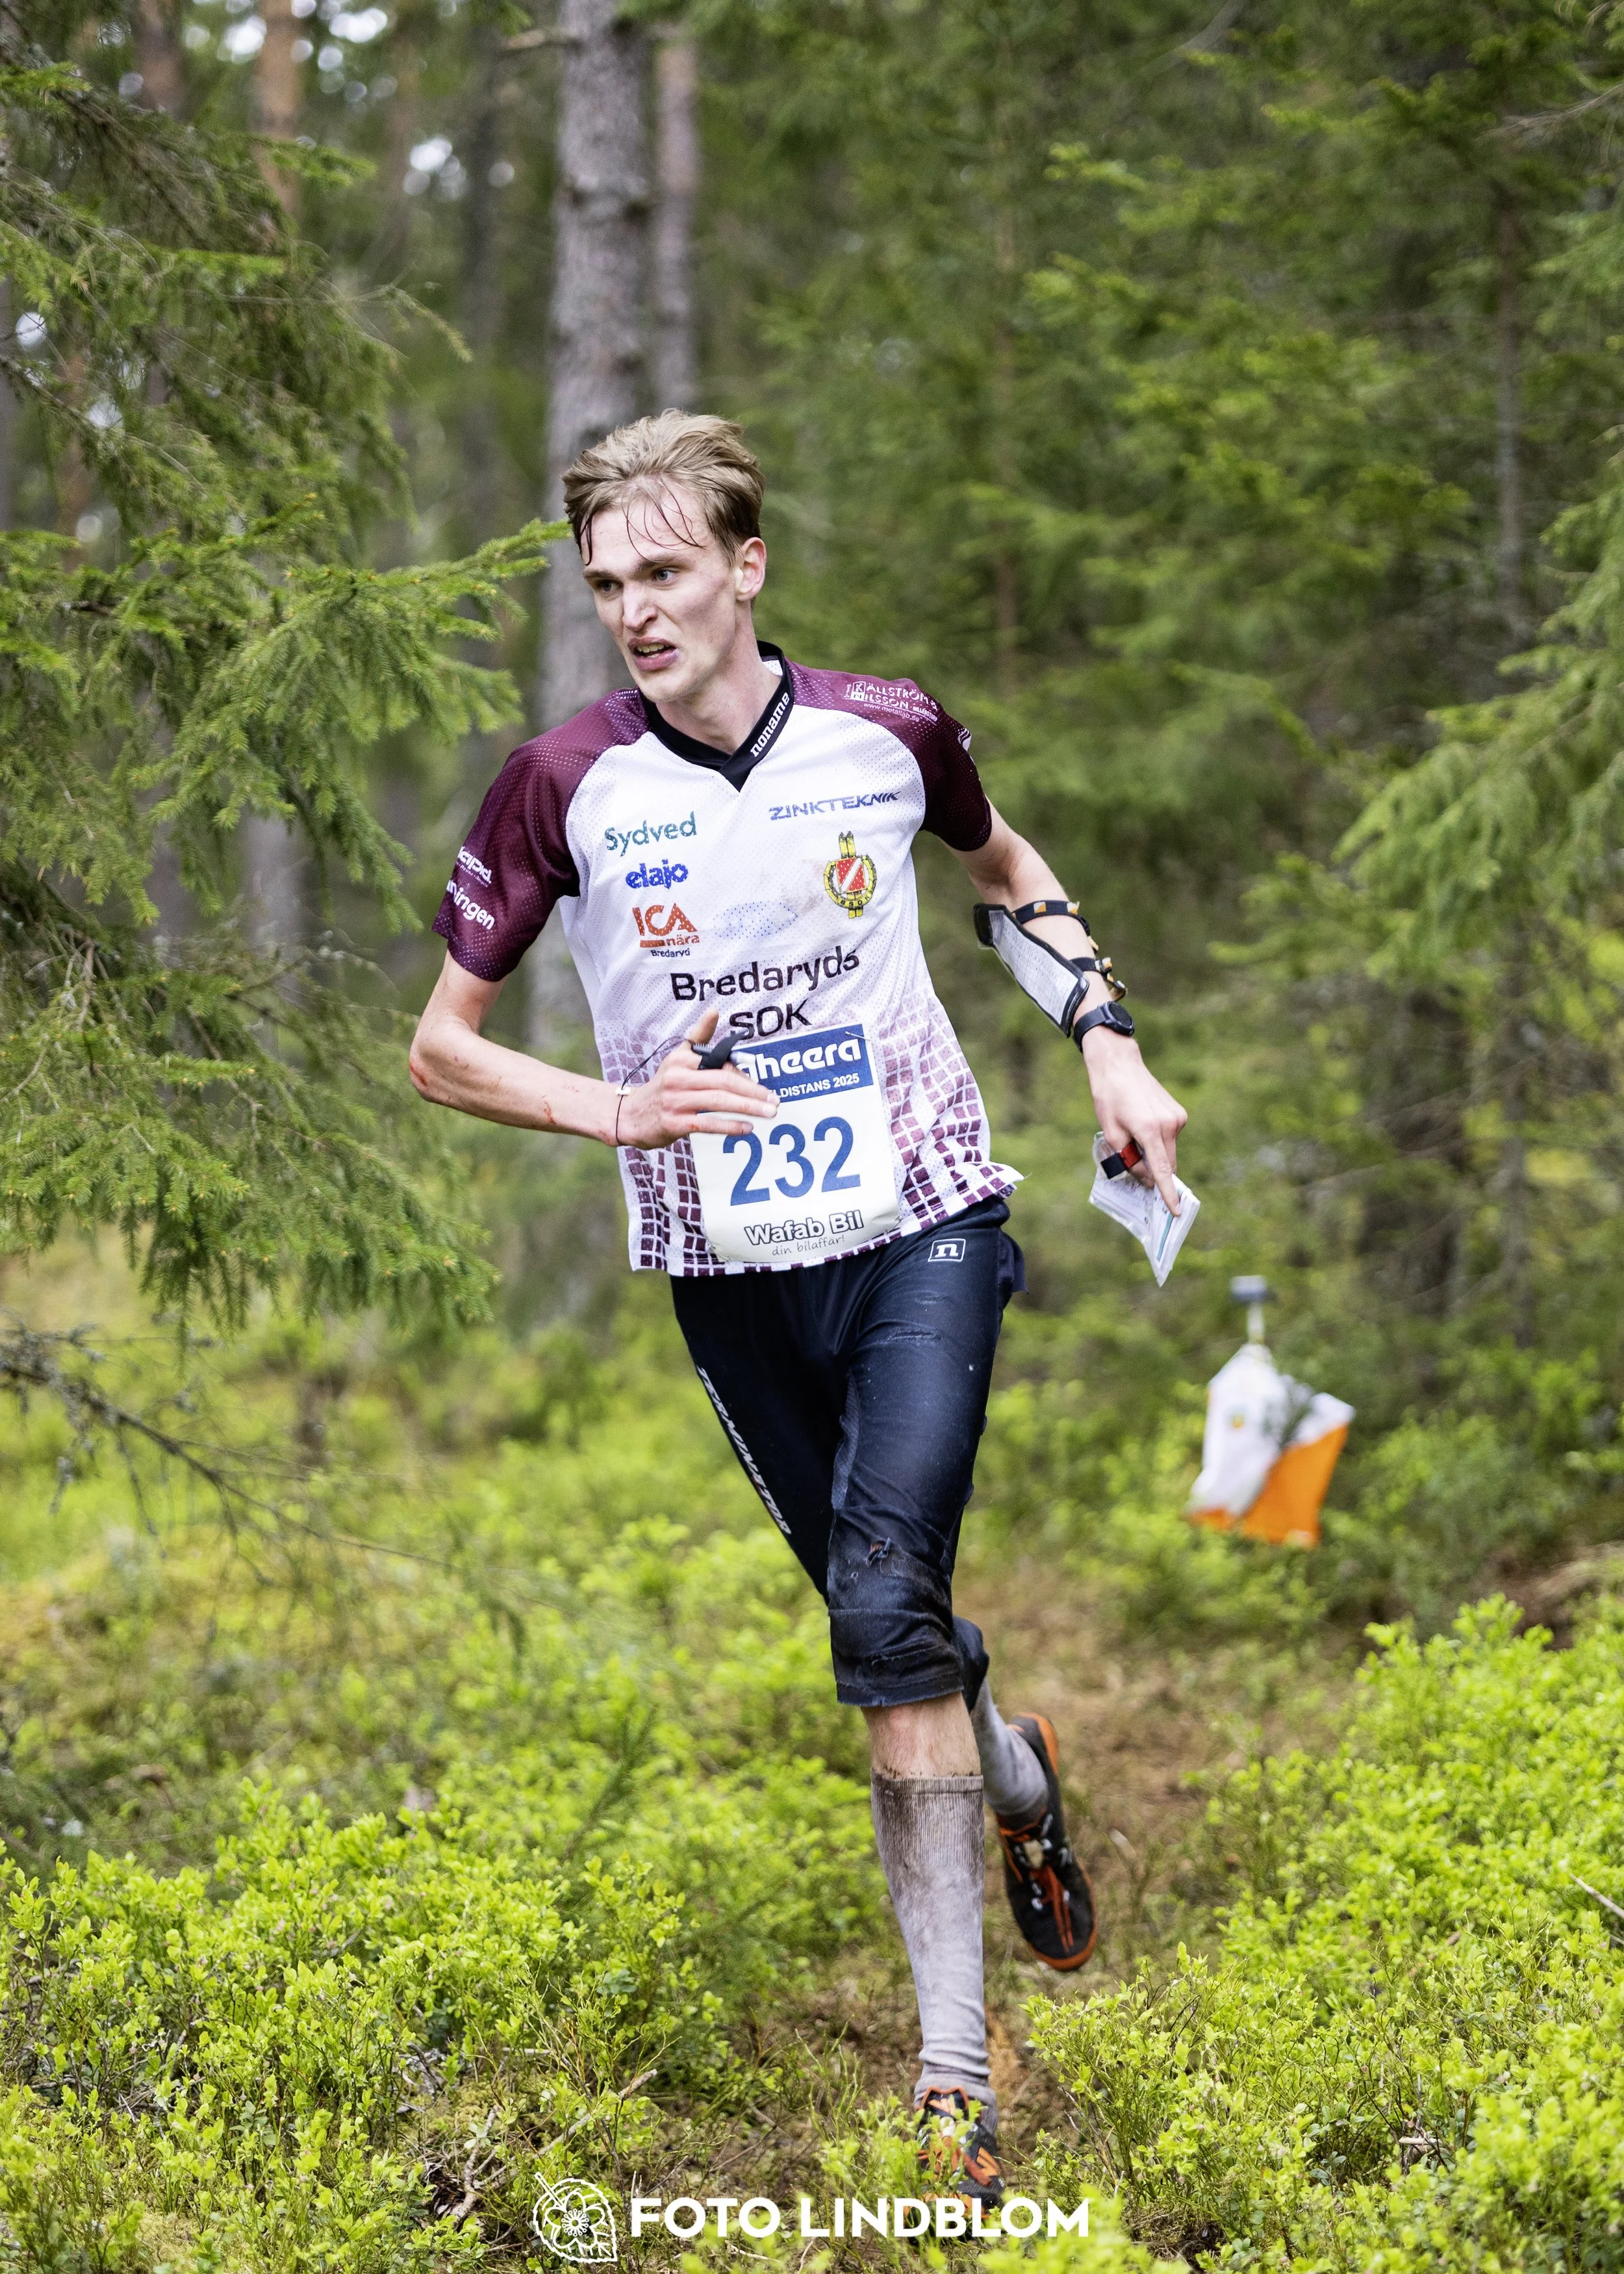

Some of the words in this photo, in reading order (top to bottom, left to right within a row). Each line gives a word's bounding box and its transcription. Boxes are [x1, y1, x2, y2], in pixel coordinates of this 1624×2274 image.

[750, 692, 790, 758] noname
[768, 790, 902, 821] ZINKTEKNIK
[604, 810, 697, 857] Sydved
[626, 858, 689, 889] elajo
[632, 902, 698, 936] ICA
[650, 947, 691, 958] Bredaryd
[666, 934, 700, 947] nära
[670, 945, 859, 1002] Bredaryds
[729, 997, 812, 1041] SOK
[832, 1073, 861, 1089] 2025
[722, 1116, 861, 1207] 232
[744, 1217, 825, 1246] Wafab
[828, 1209, 865, 1234] Bil
[772, 1246, 792, 1256] din
[796, 1234, 845, 1253] bilaffär!
[696, 1364, 792, 1535] TERMINATOR
